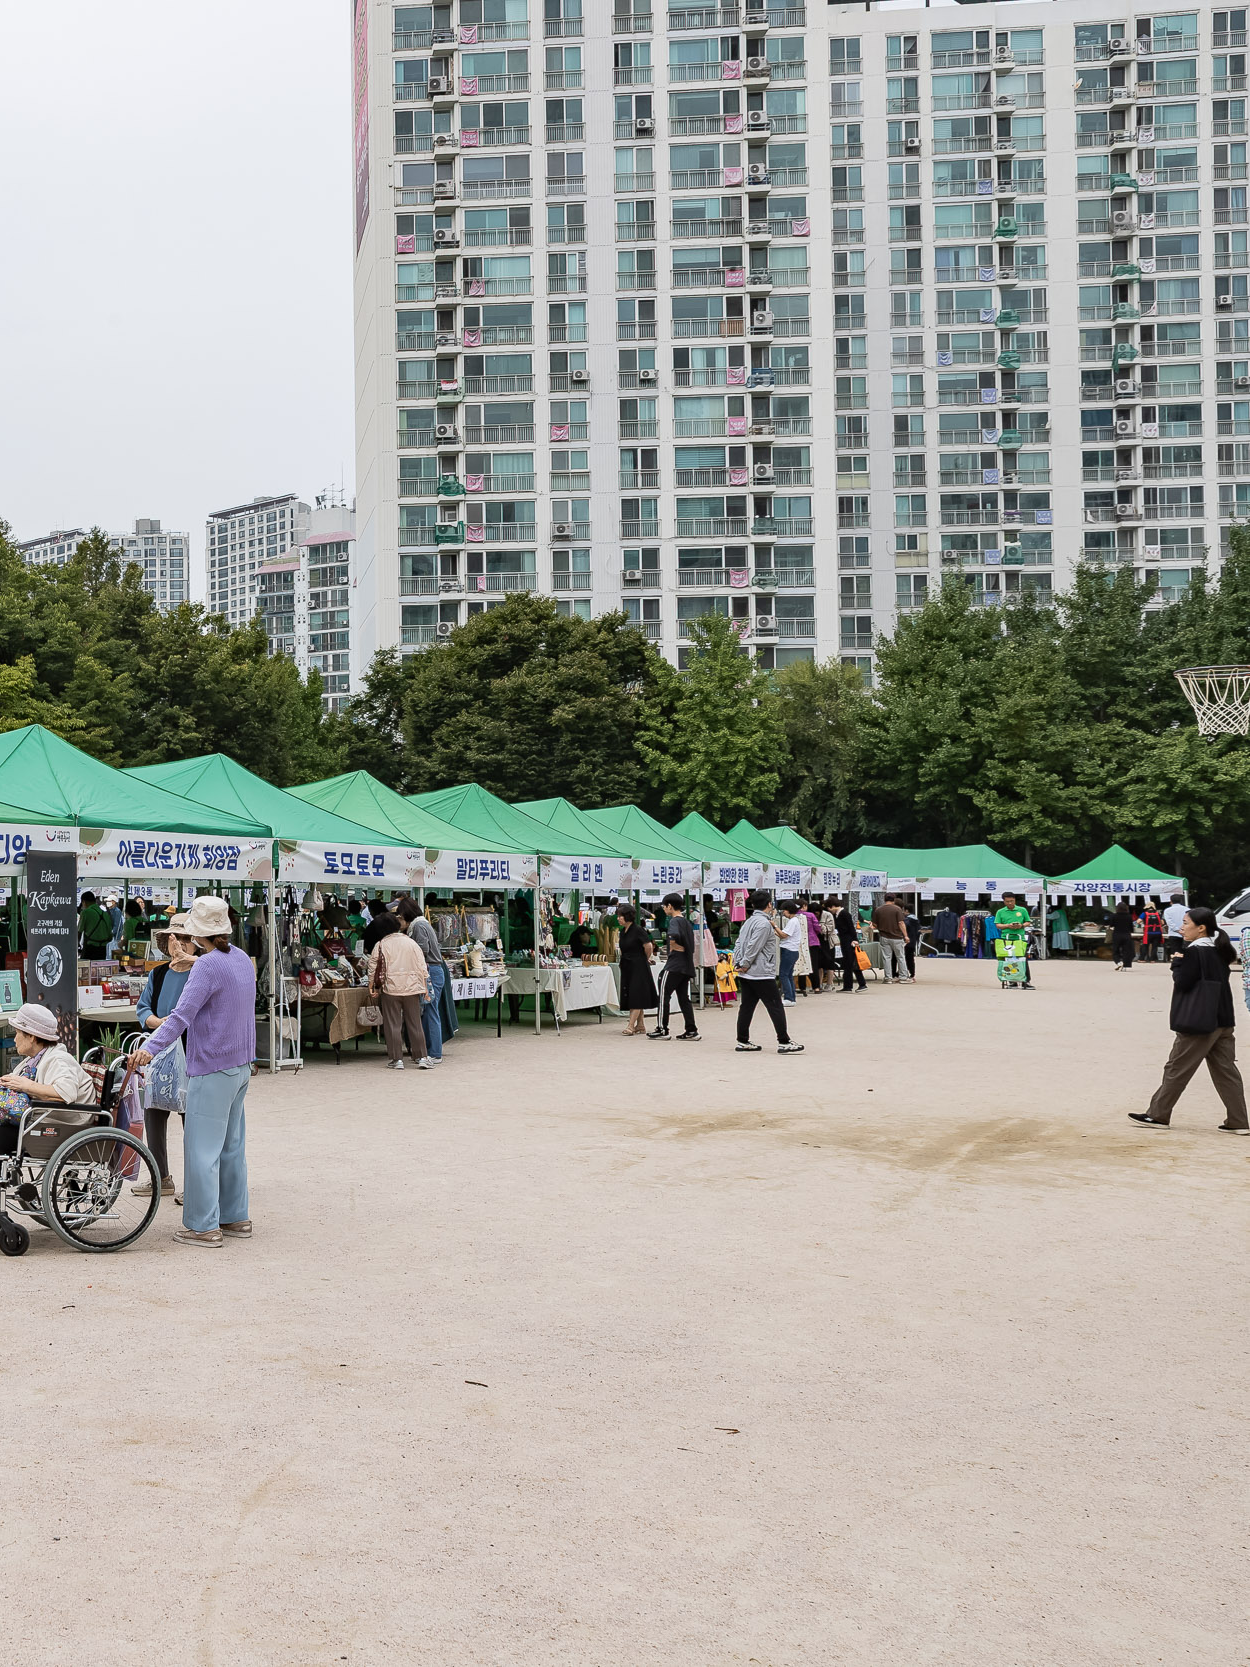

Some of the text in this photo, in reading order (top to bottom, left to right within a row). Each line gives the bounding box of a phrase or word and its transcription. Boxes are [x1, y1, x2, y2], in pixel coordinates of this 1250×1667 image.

[117, 840, 201, 870] 아름다운가게
[324, 851, 385, 877] 토모토모
[40, 870, 60, 883] Eden
[456, 858, 511, 881] 말티푸리티
[652, 865, 683, 884] 느린공간
[1073, 882, 1152, 893] 자양전통시장
[28, 891, 72, 911] Kapkawa
